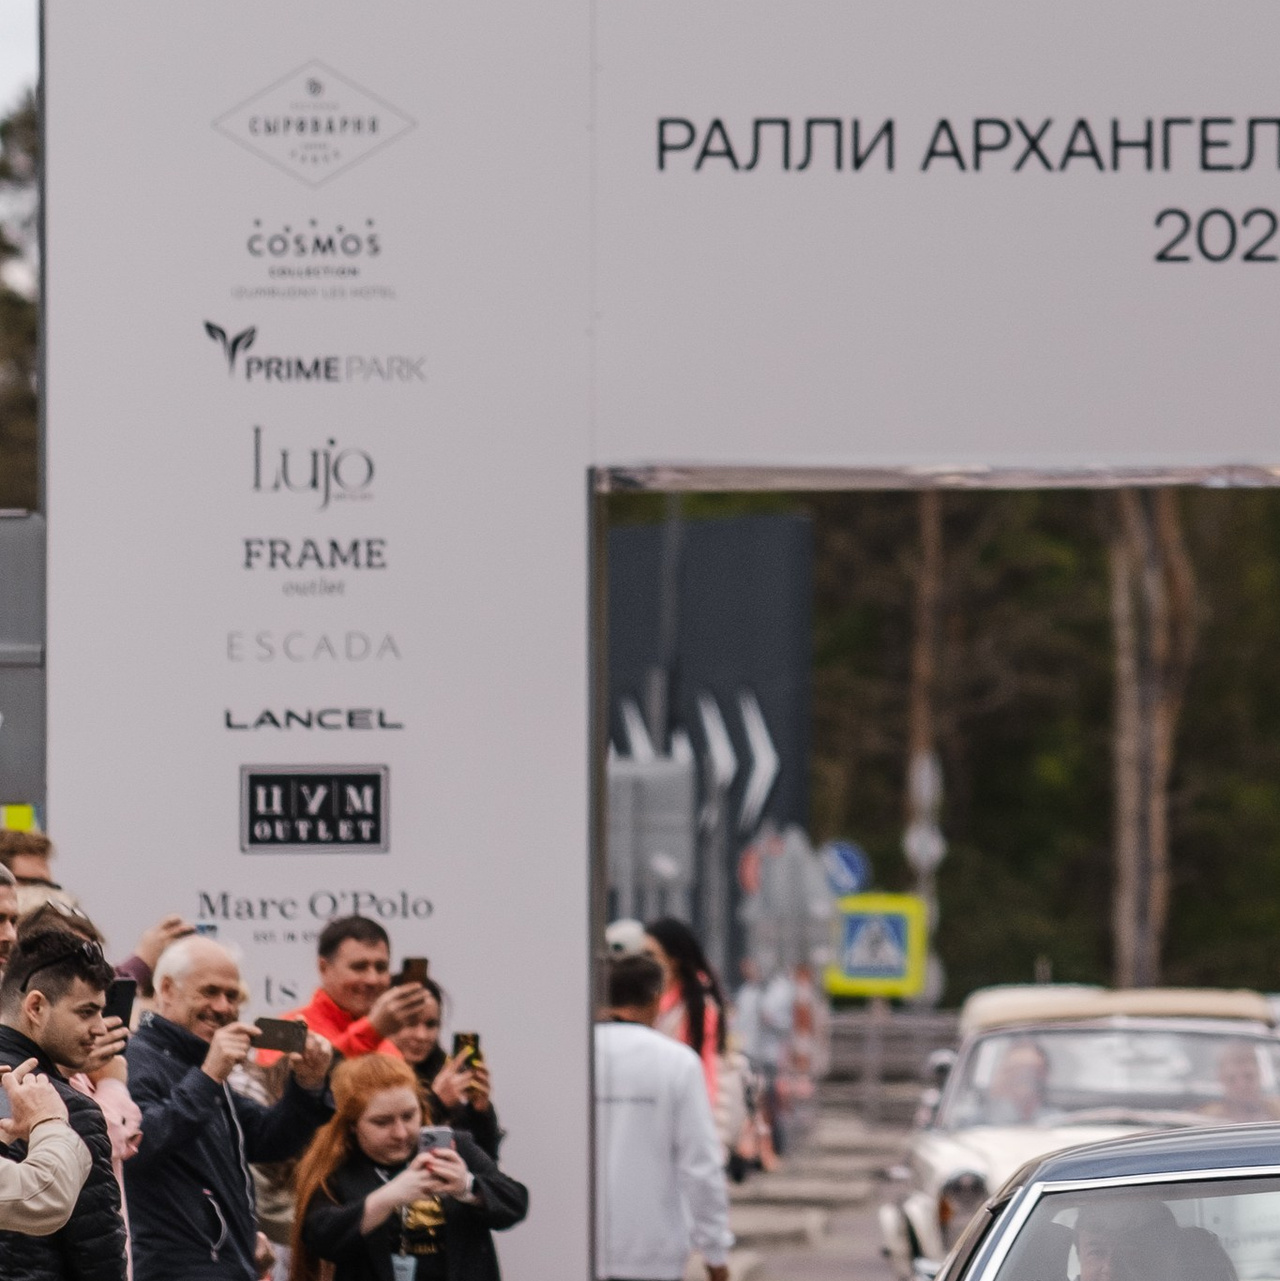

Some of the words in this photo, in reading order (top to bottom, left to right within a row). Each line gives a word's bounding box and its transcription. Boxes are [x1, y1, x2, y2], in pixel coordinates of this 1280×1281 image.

[657, 117, 895, 171] РАЛЛИ
[246, 233, 382, 258] COSMOS
[242, 537, 388, 570] FRAME
[225, 630, 402, 662] ESCADA
[225, 708, 405, 730] LANCEL
[253, 819, 376, 841] OUTLET
[198, 890, 298, 921] Marc
